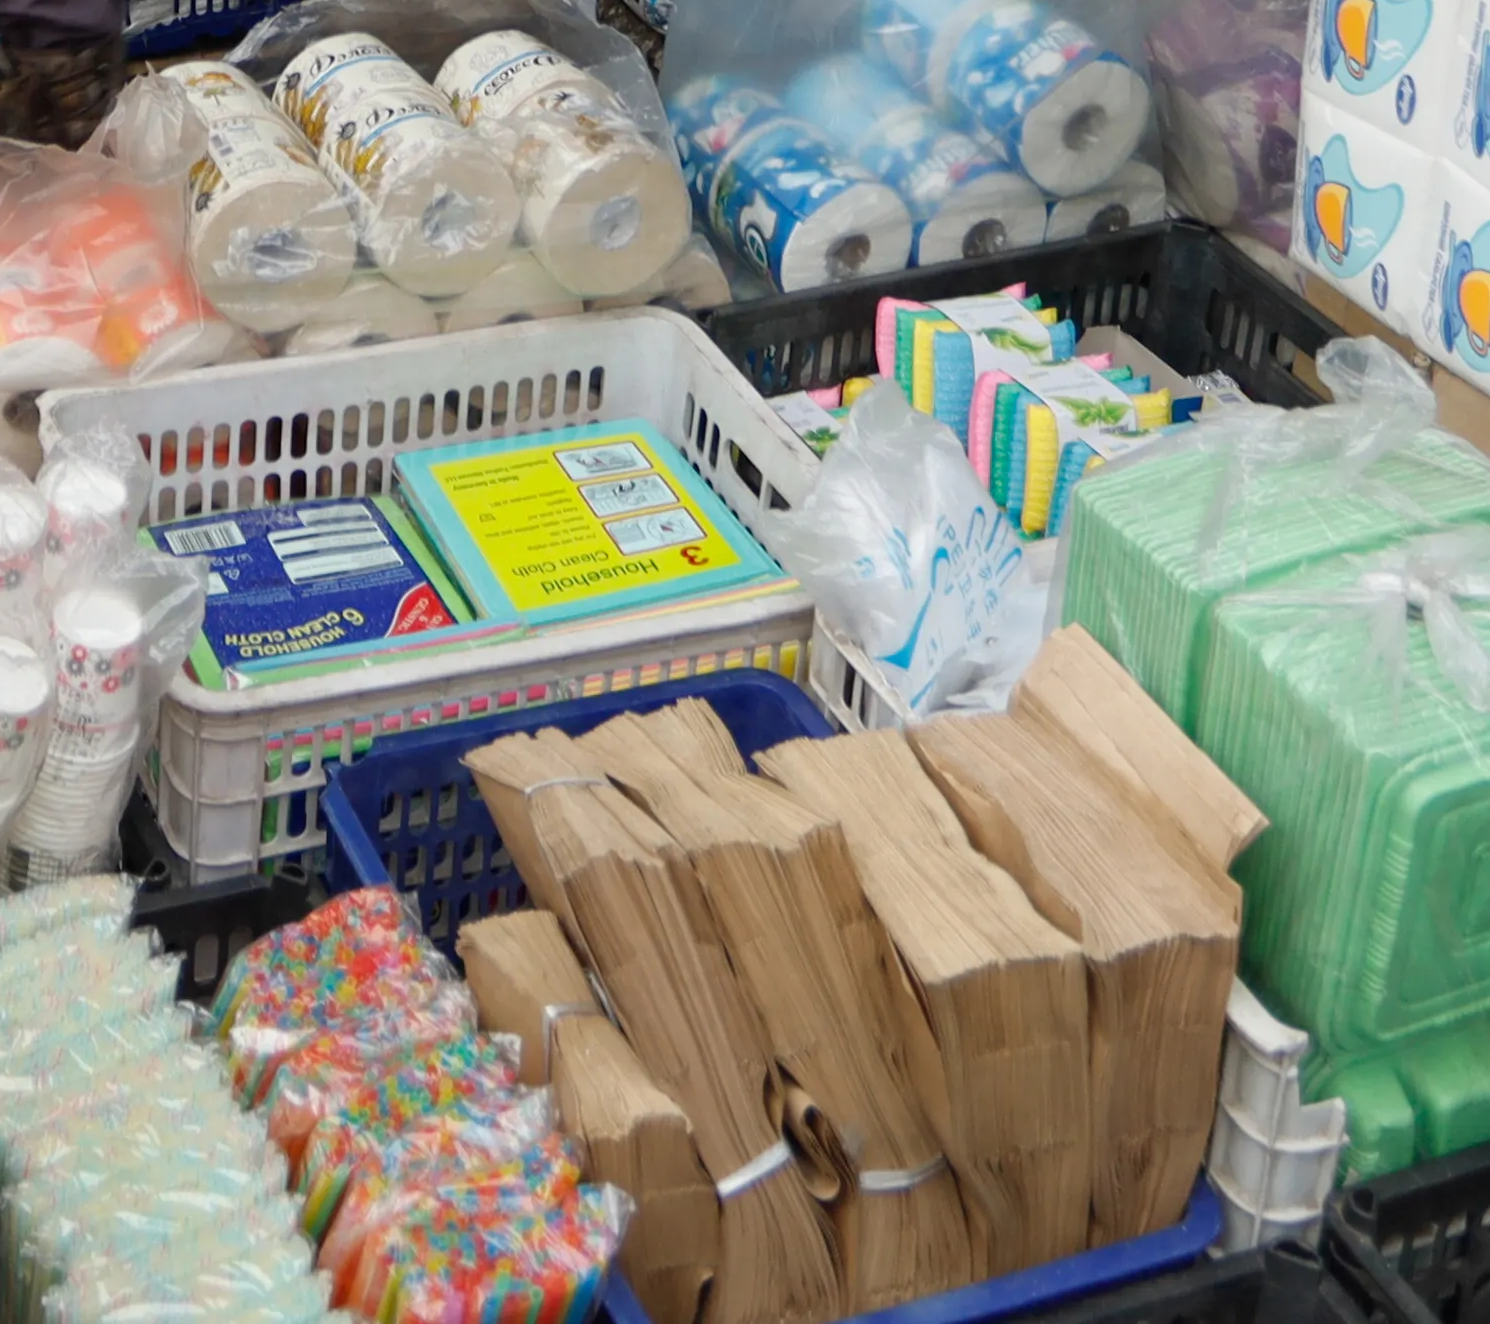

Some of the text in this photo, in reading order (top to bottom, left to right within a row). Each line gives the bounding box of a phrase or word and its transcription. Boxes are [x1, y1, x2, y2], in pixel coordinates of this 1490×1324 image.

[511, 549, 610, 580] Clean Cloth
[540, 557, 660, 596] Household
[224, 610, 342, 649] CLEAN CLOTH
[239, 627, 346, 657] HOUSEHOLD
